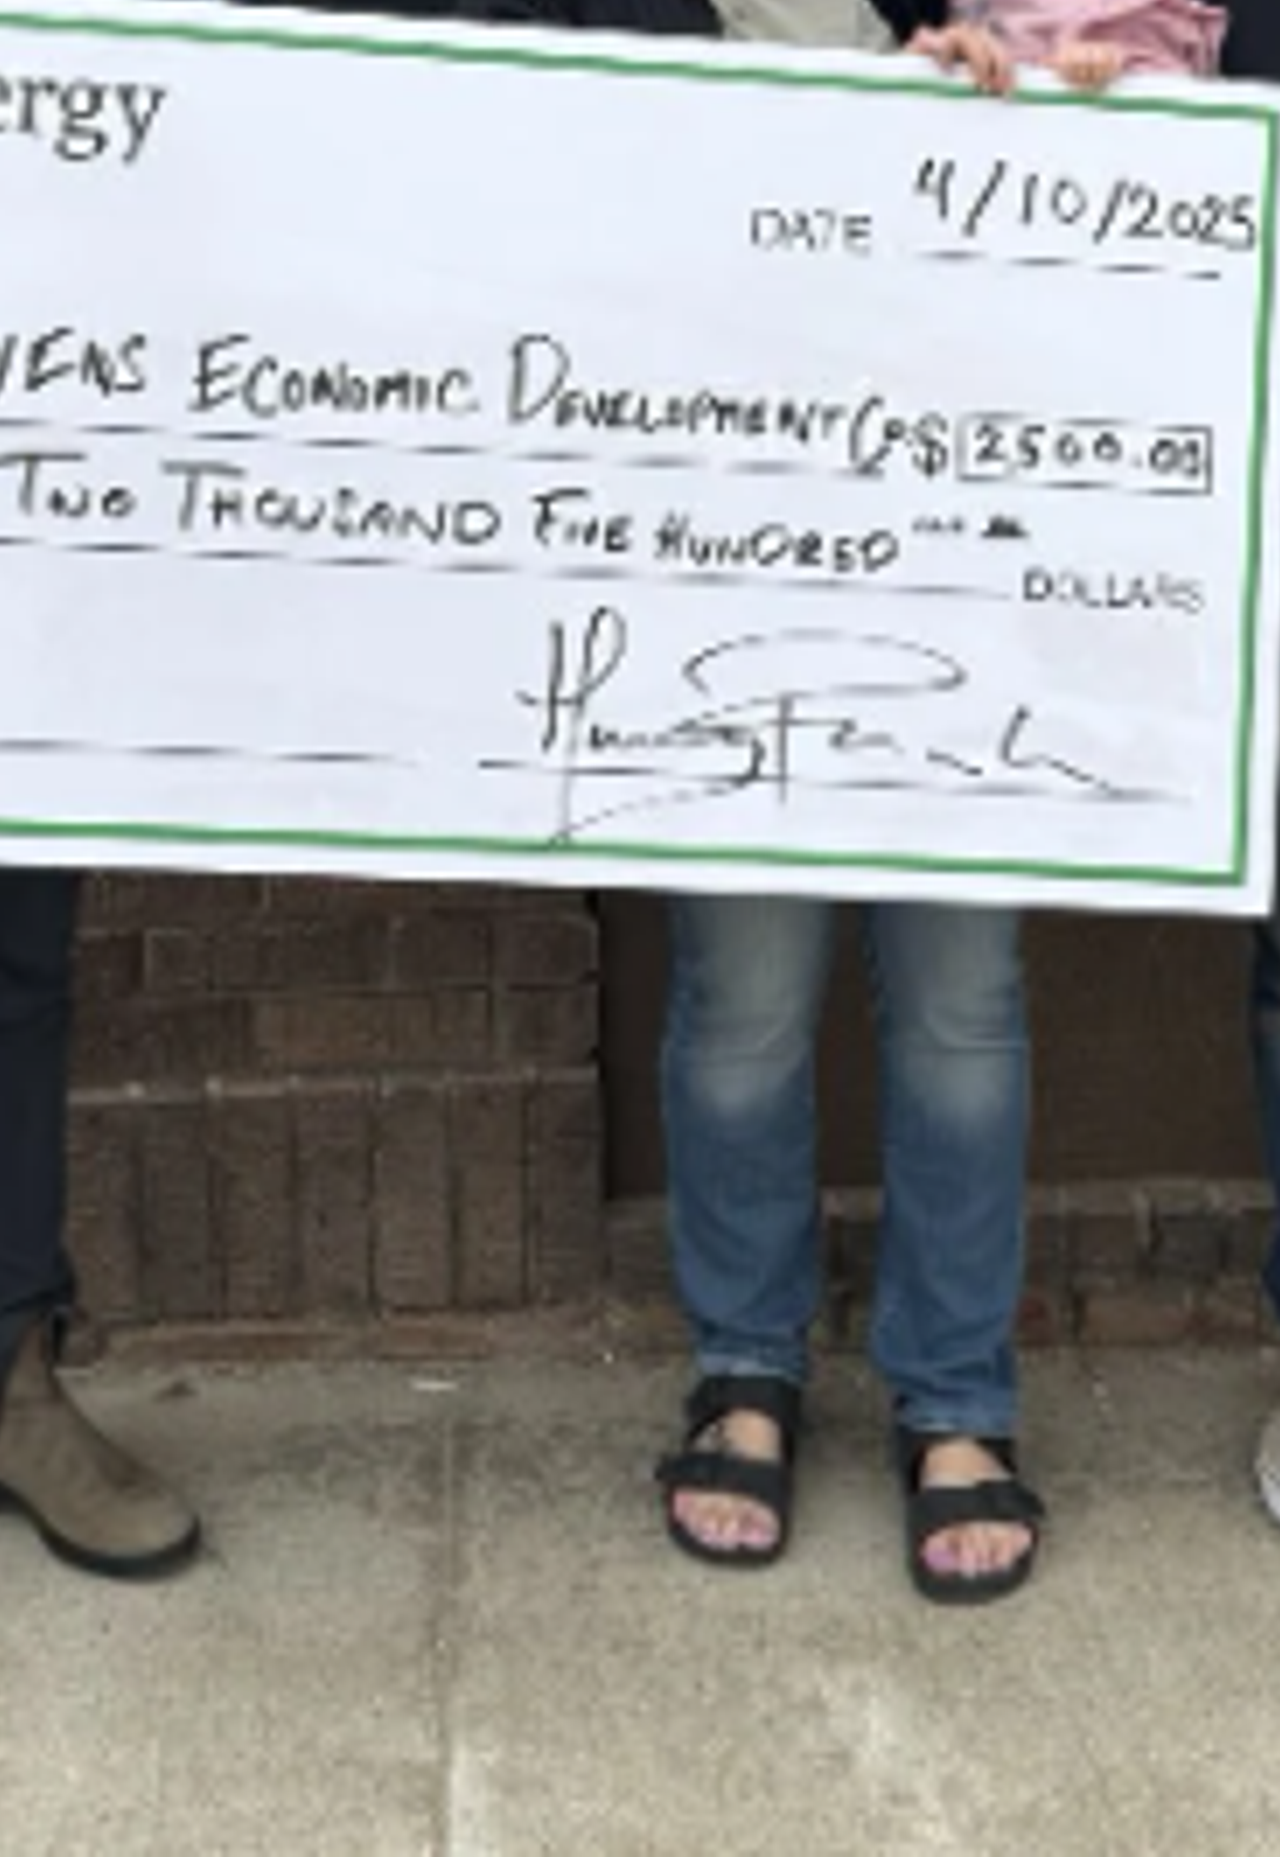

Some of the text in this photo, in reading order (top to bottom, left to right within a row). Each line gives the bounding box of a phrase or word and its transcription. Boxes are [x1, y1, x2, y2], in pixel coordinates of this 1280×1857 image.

[750, 208, 873, 253] DATE
[914, 157, 1257, 252] 4/10/2025
[911, 411, 949, 478] $
[1022, 567, 1206, 614] DOLLARS
